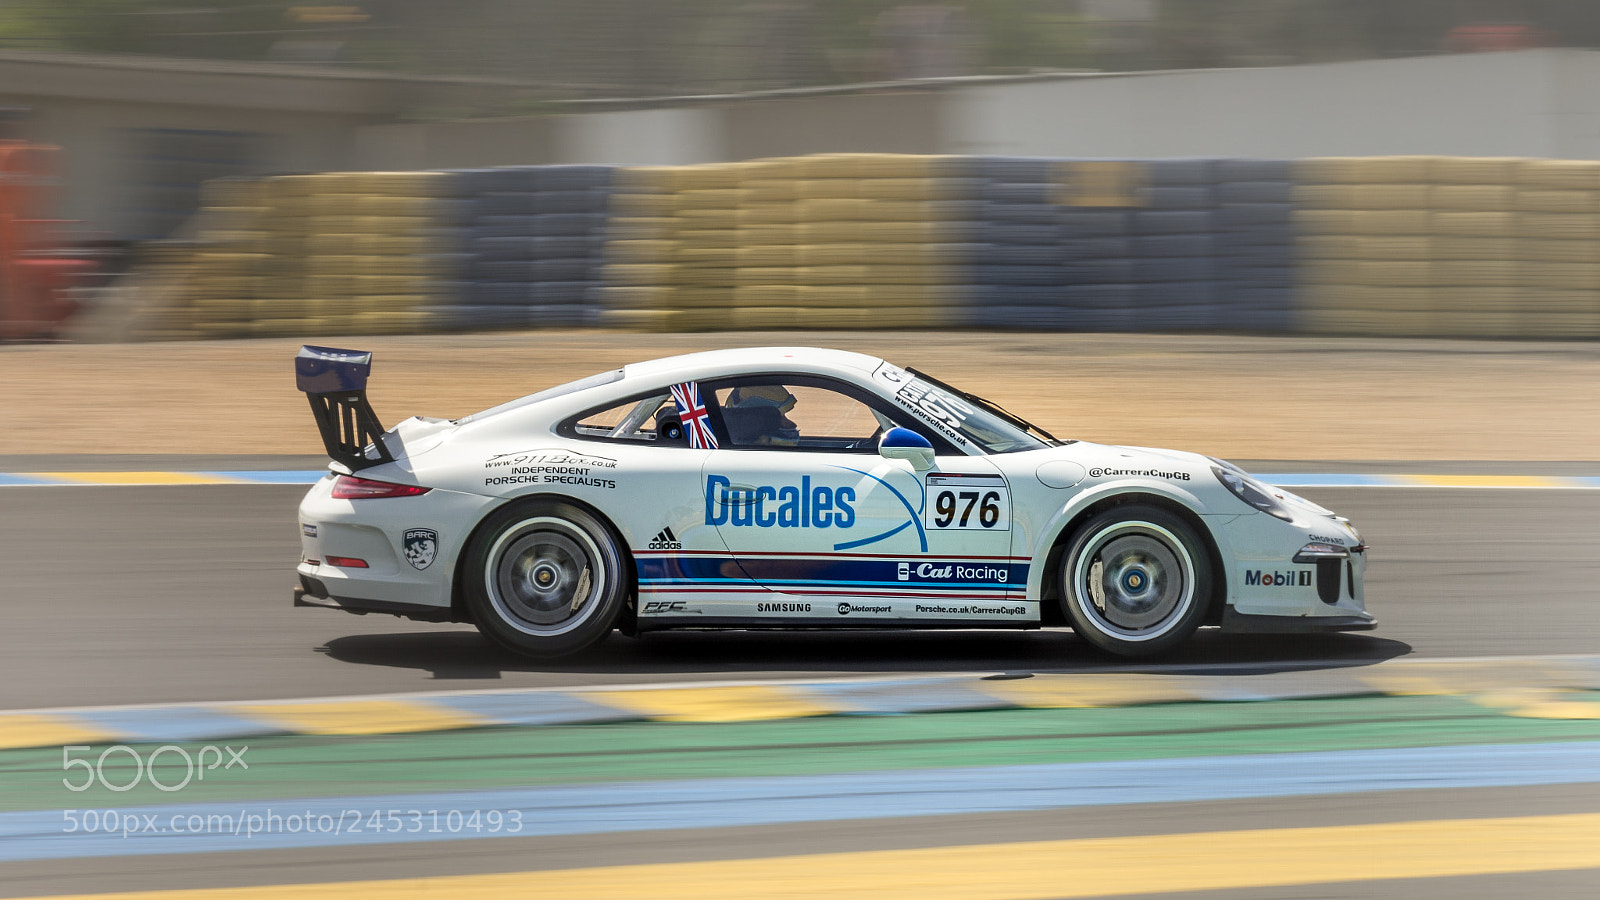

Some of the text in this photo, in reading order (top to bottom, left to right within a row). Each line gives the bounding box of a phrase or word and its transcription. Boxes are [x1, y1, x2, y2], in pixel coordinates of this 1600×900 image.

[894, 395, 968, 447] www.porsche.co.uk
[511, 466, 591, 476] INDEPENDENT
[1088, 466, 1191, 481] @CarreraCupGB
[485, 475, 617, 489] PORSCHE SPECIALISTS
[704, 474, 856, 529] Ducales
[934, 490, 1001, 528] 976
[406, 530, 435, 540] BARC
[1308, 534, 1345, 546] CHOPARD
[648, 540, 682, 550] adidas
[956, 566, 1008, 583] Racing
[1245, 570, 1311, 586] Mobil 1
[644, 601, 687, 610] PFC
[757, 602, 812, 612] SAMSUNG
[915, 604, 1027, 616] Porsche.co.uk/CarreraCupGB
